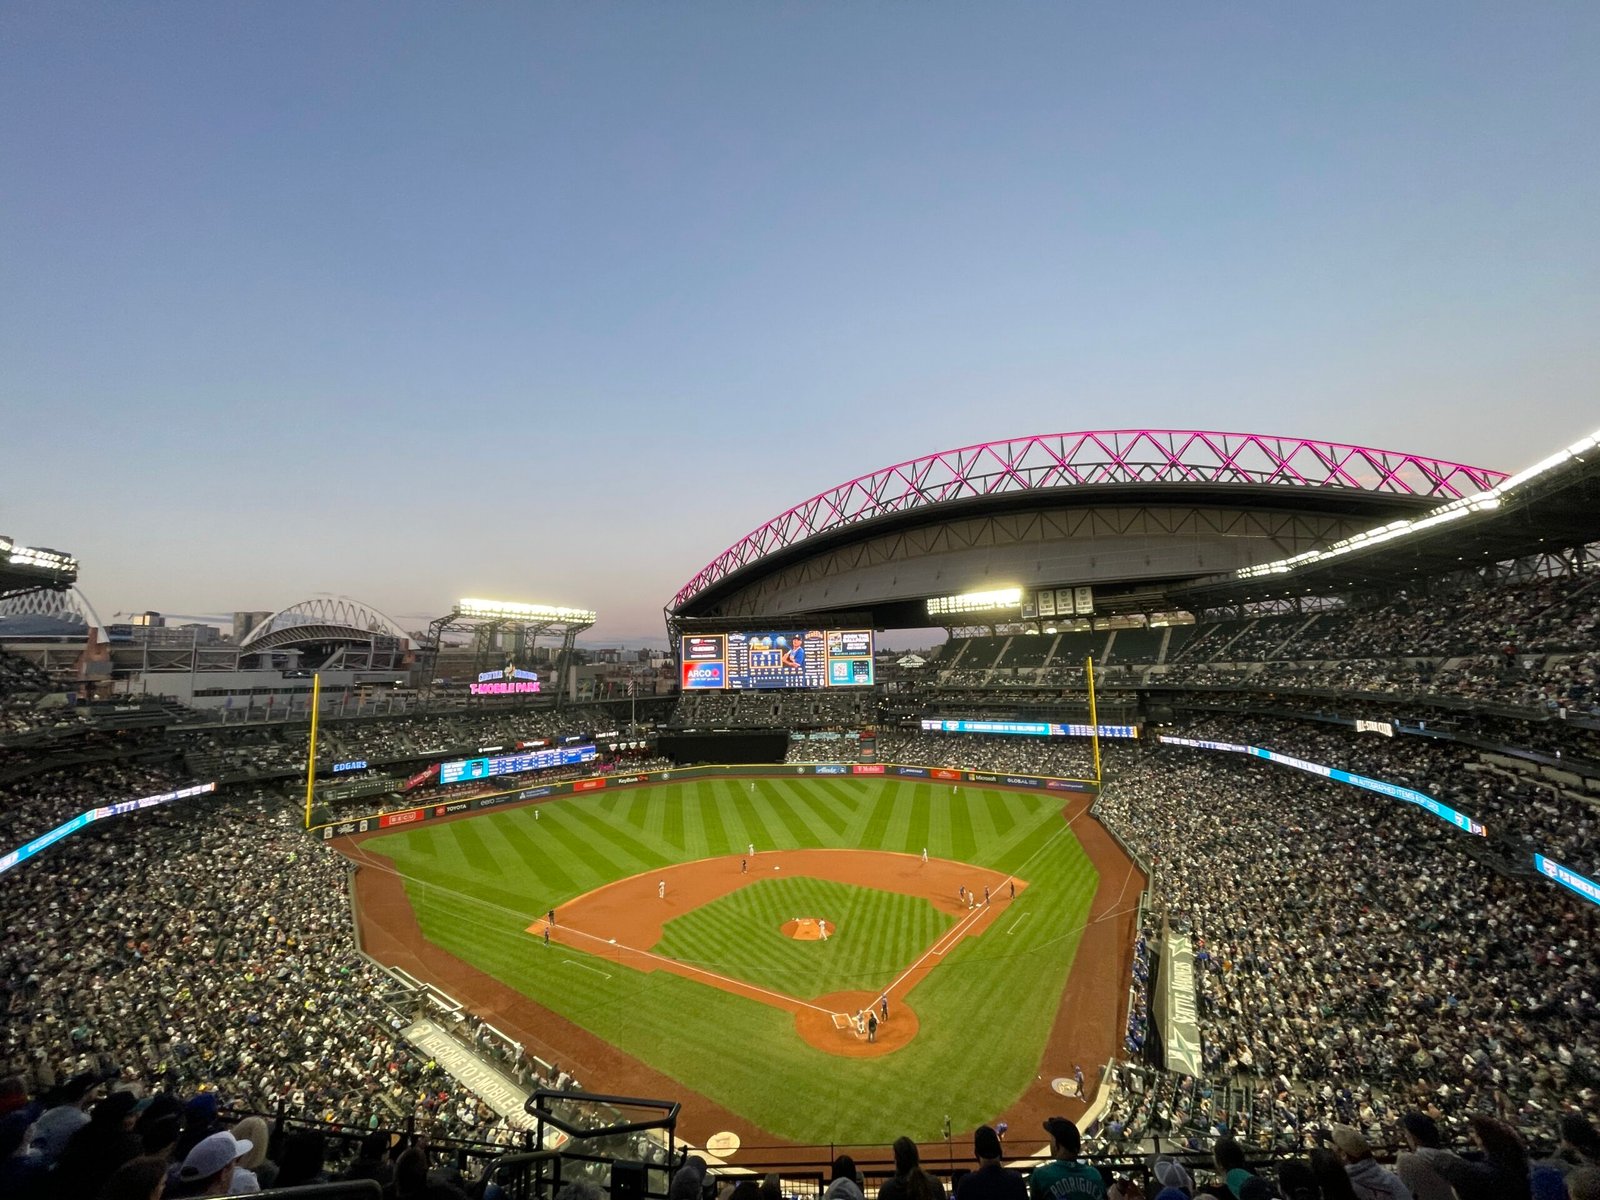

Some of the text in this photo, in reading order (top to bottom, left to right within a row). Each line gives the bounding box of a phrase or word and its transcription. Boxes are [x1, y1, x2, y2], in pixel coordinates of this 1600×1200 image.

[688, 669, 712, 677] ARCO
[469, 682, 540, 695] T-MOBILE PARK
[446, 804, 467, 813] TOYOTA
[420, 1035, 463, 1069] WELCOME
[457, 1062, 477, 1078] TO
[469, 1072, 517, 1110] T-MOBILE
